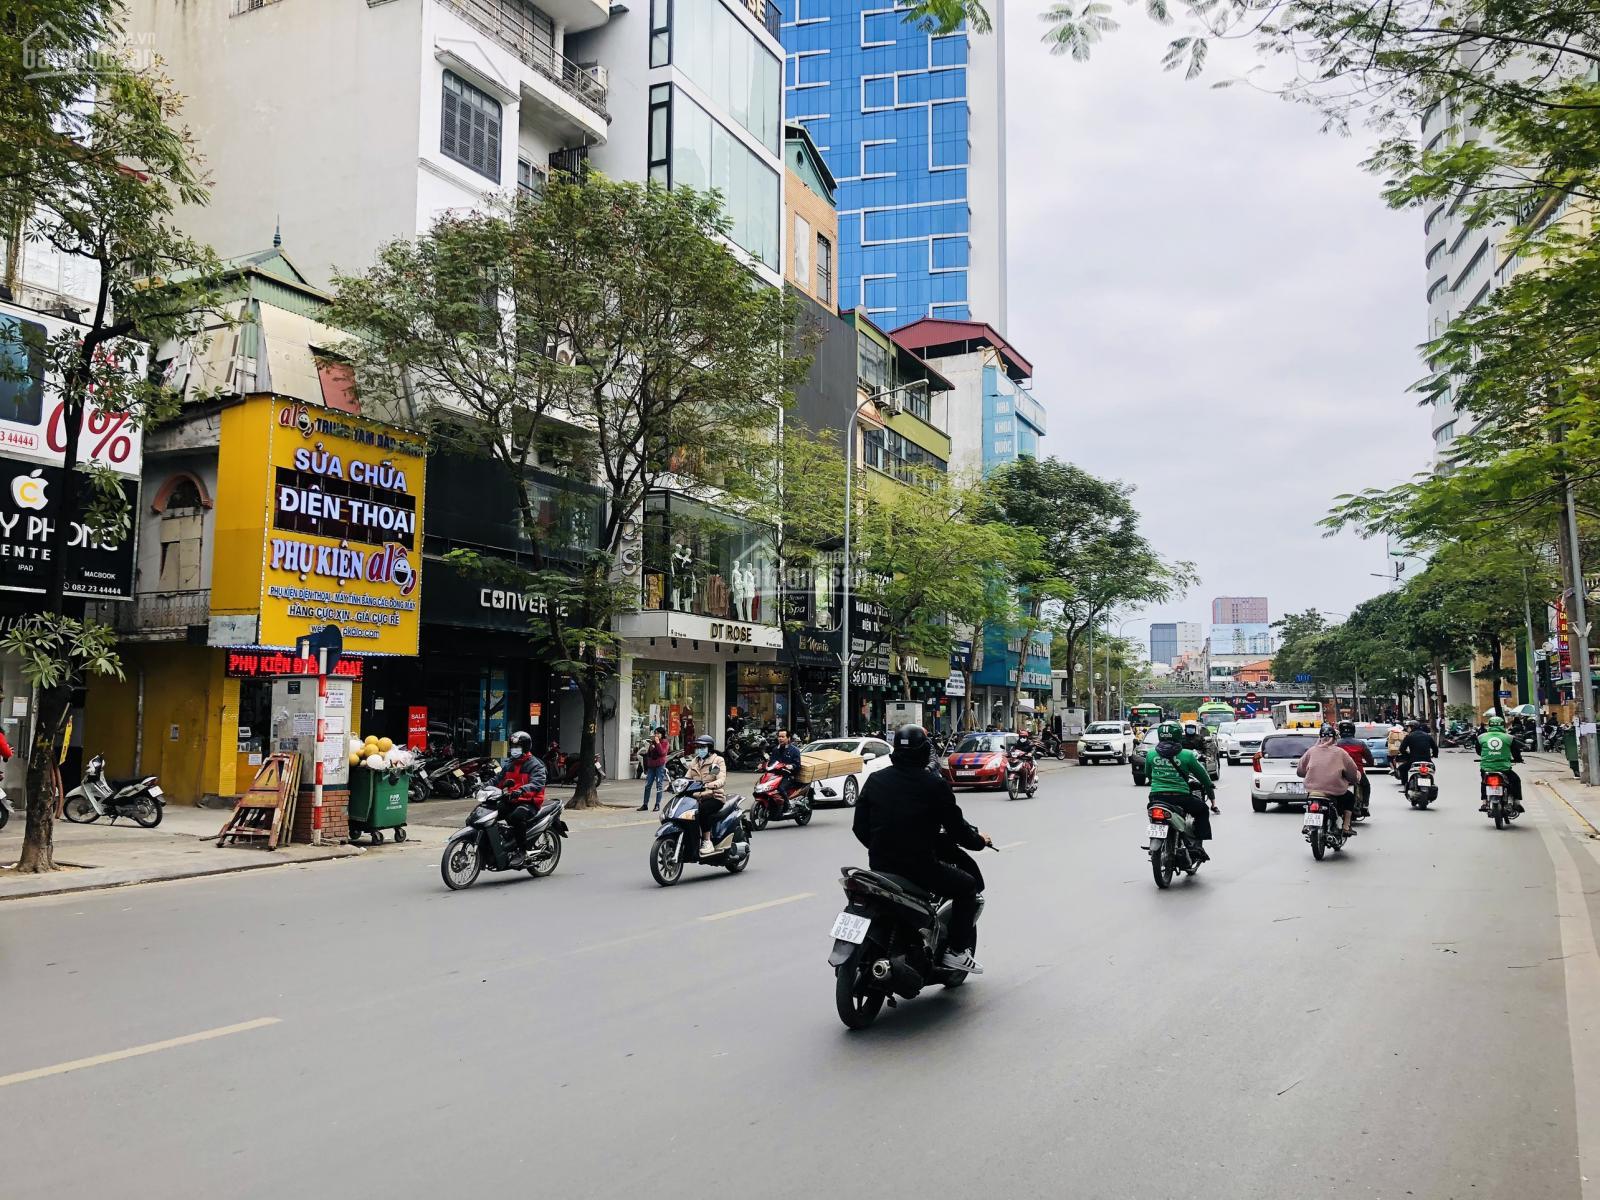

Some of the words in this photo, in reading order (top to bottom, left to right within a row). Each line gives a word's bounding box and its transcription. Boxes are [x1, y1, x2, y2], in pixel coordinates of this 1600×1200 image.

[7, 431, 34, 447] 44444
[294, 442, 344, 478] SỬA
[348, 459, 408, 492] CHỮA
[279, 484, 341, 524] ĐIỆN
[347, 500, 416, 539] THOẠI
[270, 538, 315, 582] PHỤ
[315, 539, 365, 586] KIỆN
[84, 570, 117, 580] MACBOOK
[71, 583, 86, 592] 082
[87, 584, 99, 593] 23
[99, 586, 122, 595] 44444
[480, 588, 568, 617] CONVERE
[710, 622, 725, 639] DT
[725, 625, 753, 643] ROSE
[229, 654, 258, 676] PHỤ
[260, 651, 291, 675] KIỆN
